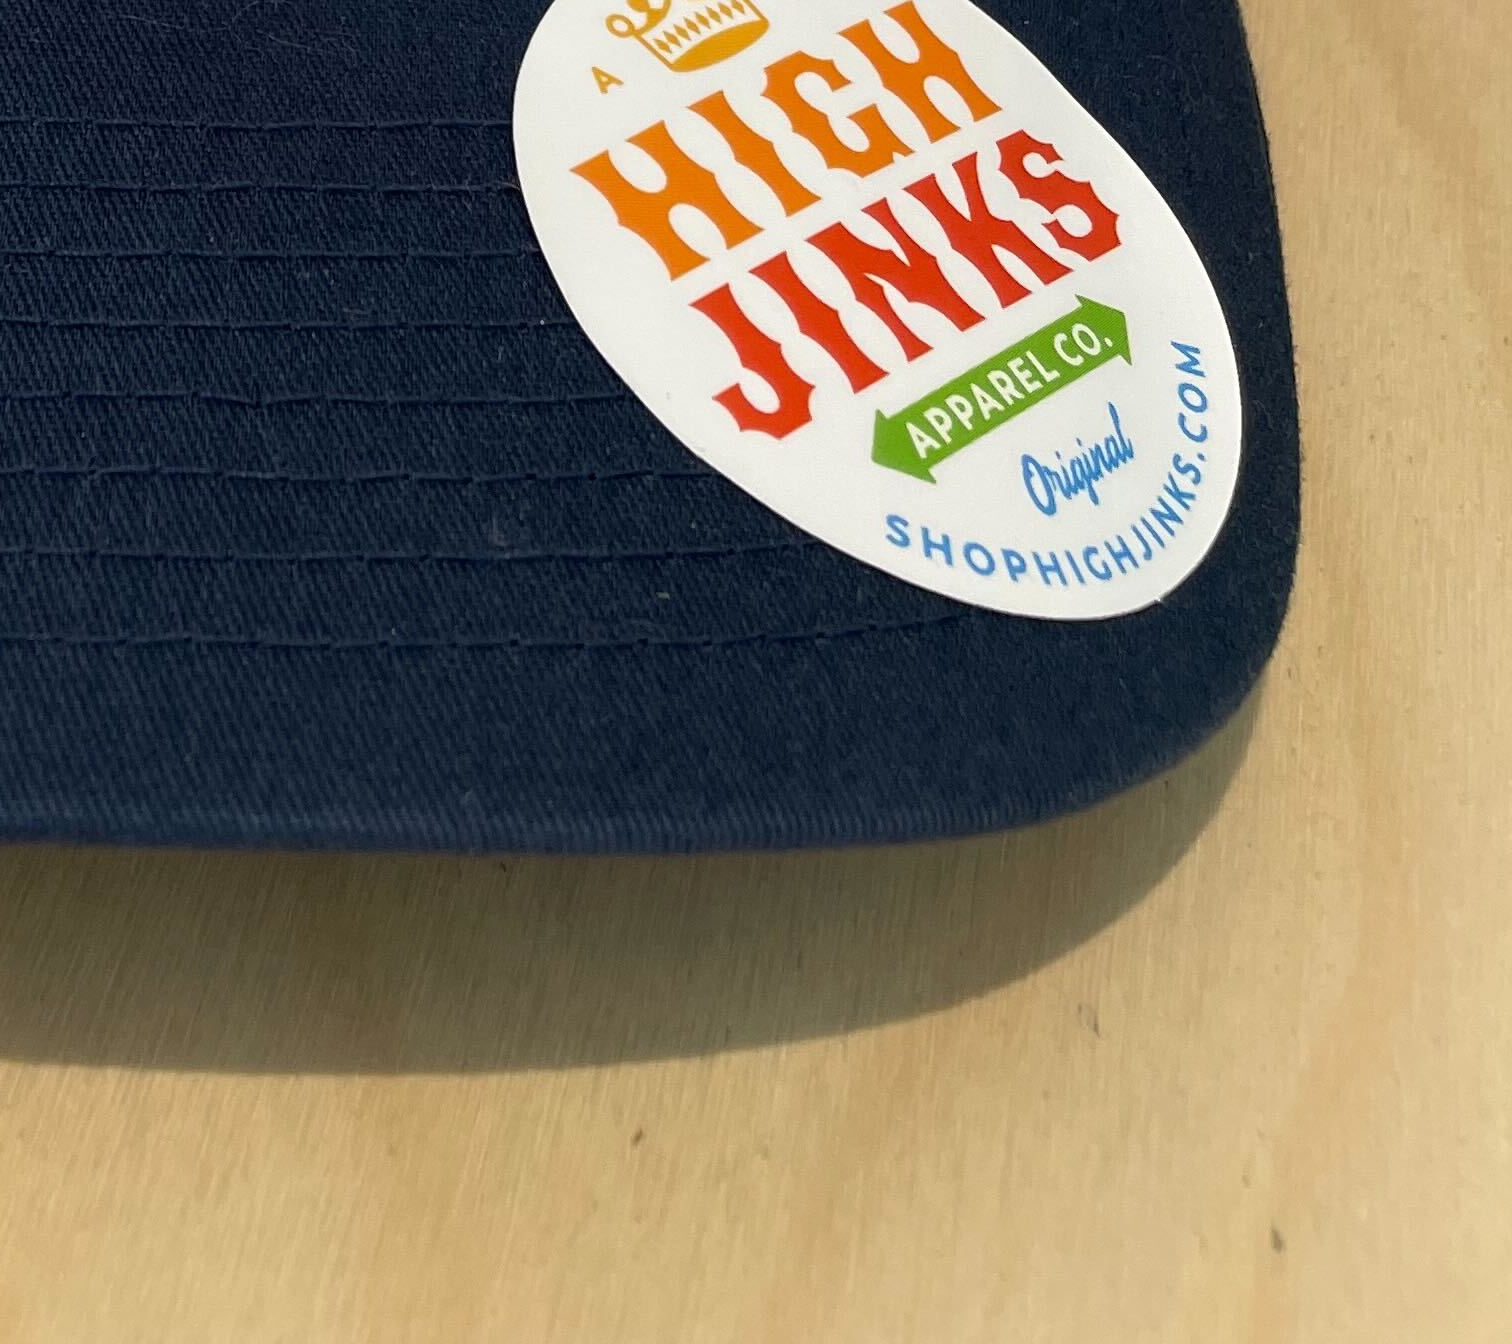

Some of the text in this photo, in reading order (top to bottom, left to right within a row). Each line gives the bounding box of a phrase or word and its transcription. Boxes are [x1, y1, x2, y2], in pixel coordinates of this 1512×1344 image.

[570, 0, 1003, 281] HIGH
[591, 67, 623, 94] A
[688, 130, 1121, 440] JINKS
[886, 340, 1209, 586] SHOPHIGHJINKS.COM
[904, 322, 1114, 460] APPAREL CO.
[1022, 402, 1134, 516] Original
